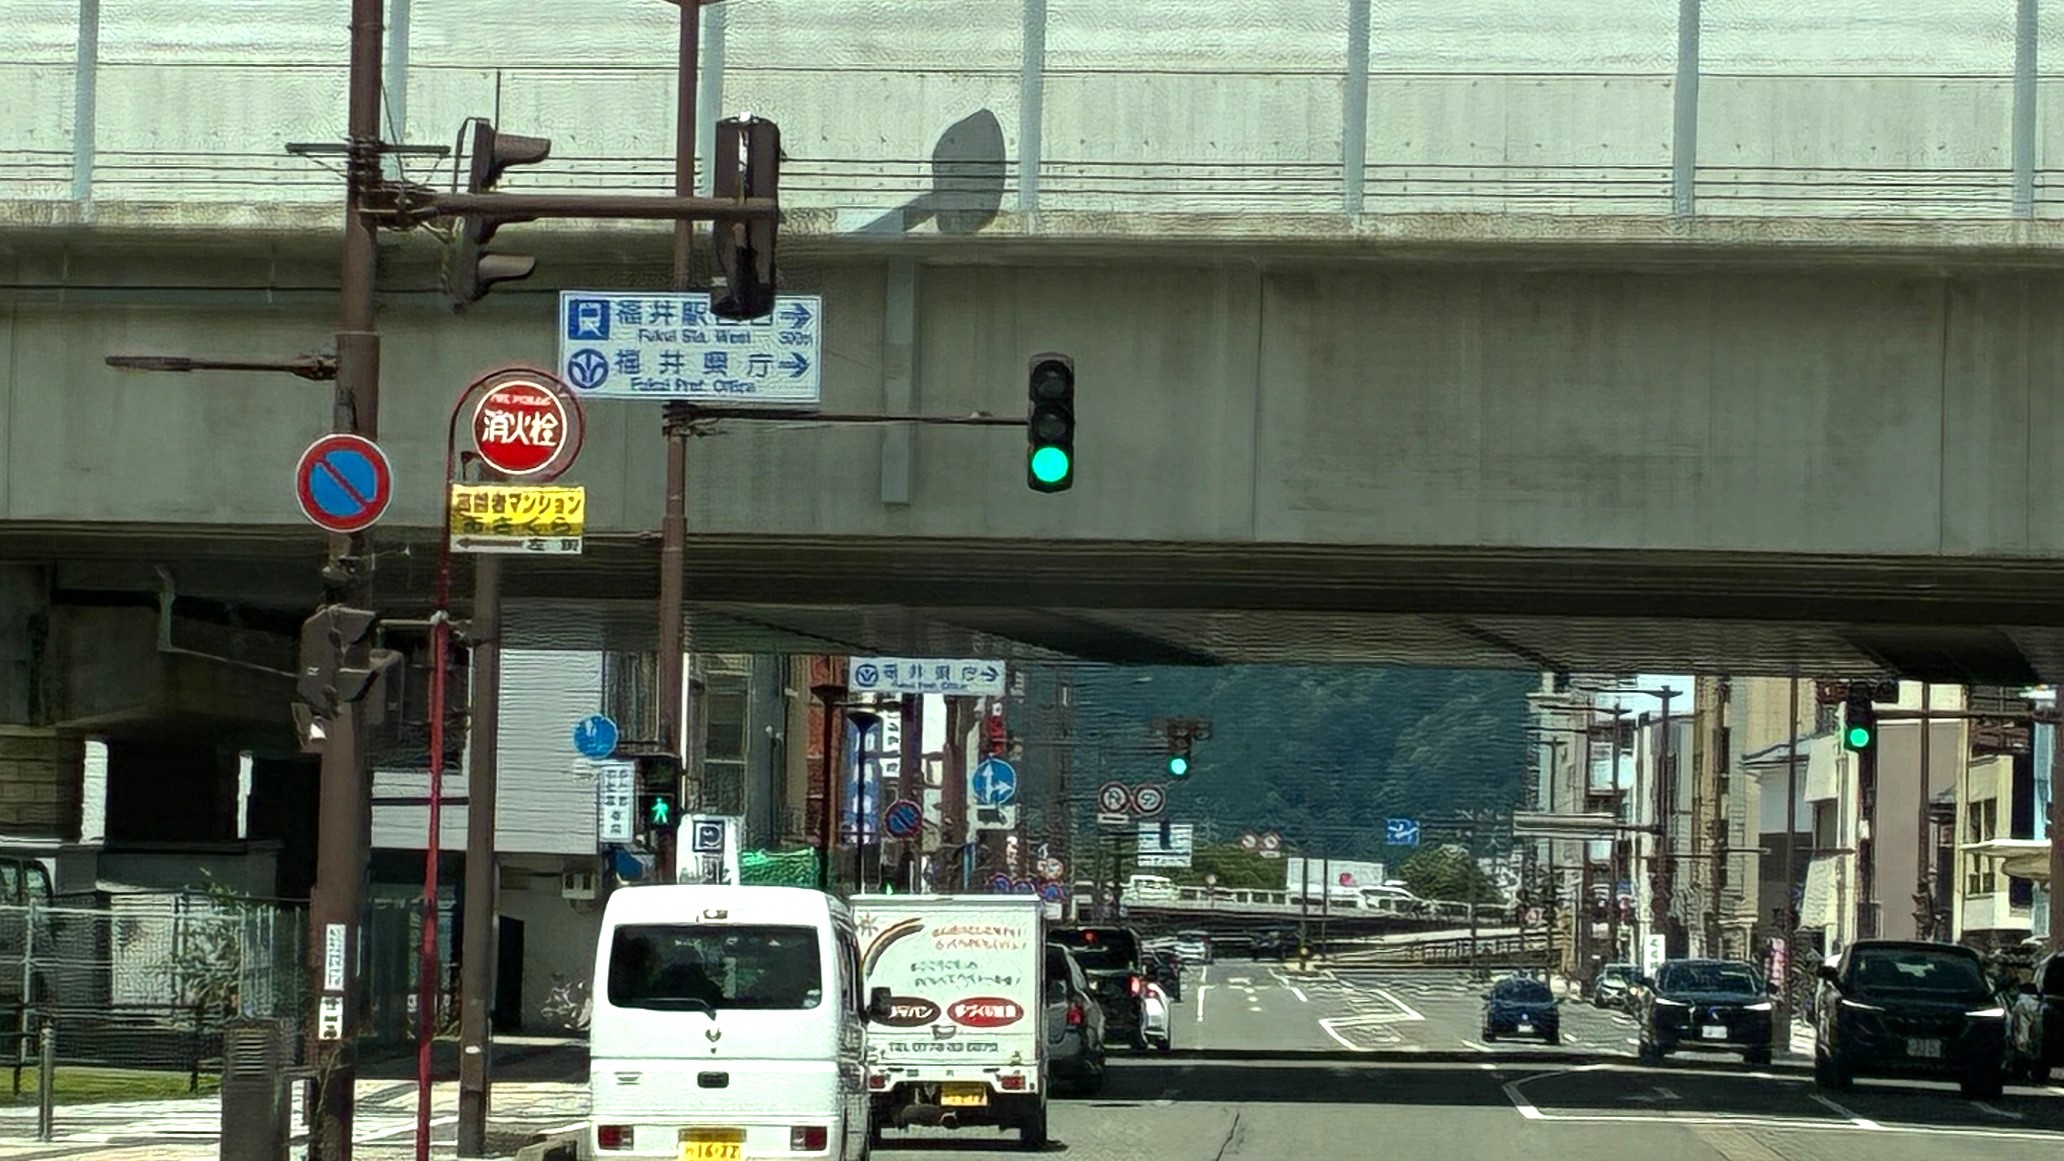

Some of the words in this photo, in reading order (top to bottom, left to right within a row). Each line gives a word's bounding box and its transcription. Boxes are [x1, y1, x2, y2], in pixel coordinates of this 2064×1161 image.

[615, 299, 773, 326] 福井駅
[615, 348, 774, 377] 福井県庁
[482, 409, 559, 446] 消火栓
